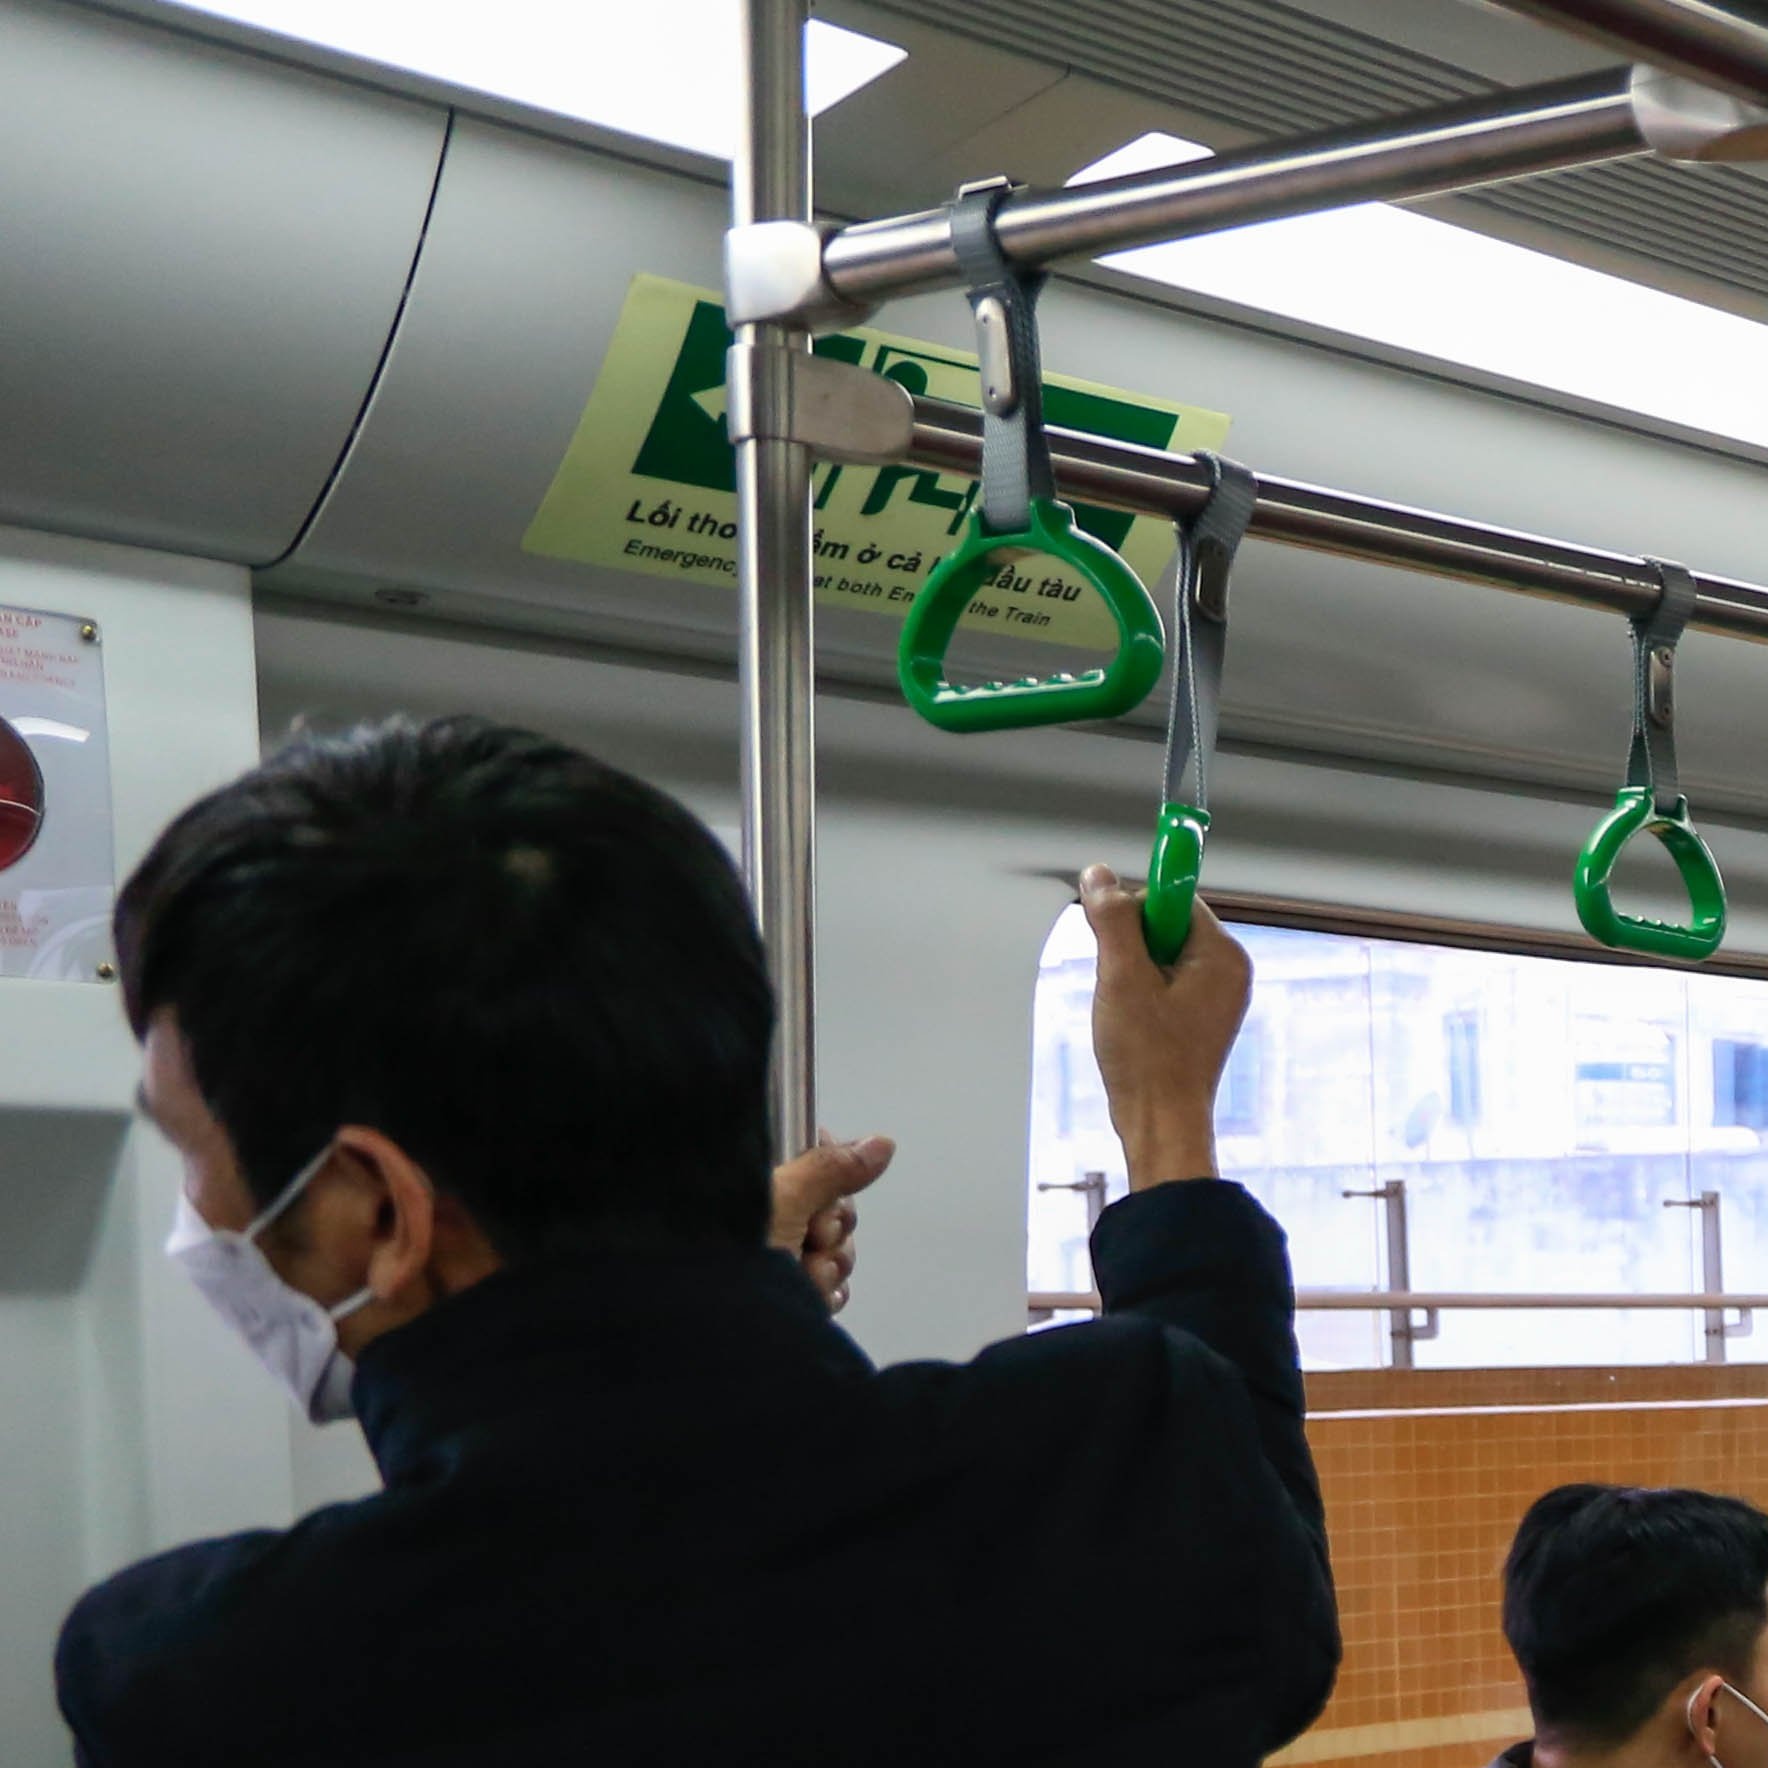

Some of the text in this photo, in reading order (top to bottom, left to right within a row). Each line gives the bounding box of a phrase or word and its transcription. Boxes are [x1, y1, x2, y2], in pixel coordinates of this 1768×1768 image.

[623, 538, 738, 576] Emergenc
[838, 580, 883, 600] both
[887, 586, 916, 603] En
[968, 601, 999, 617] the
[1004, 606, 1051, 627] Train
[626, 500, 682, 529] Lối
[687, 512, 738, 539] tho
[857, 544, 881, 564] ở
[887, 550, 922, 574] cả
[1037, 577, 1082, 602] tàu
